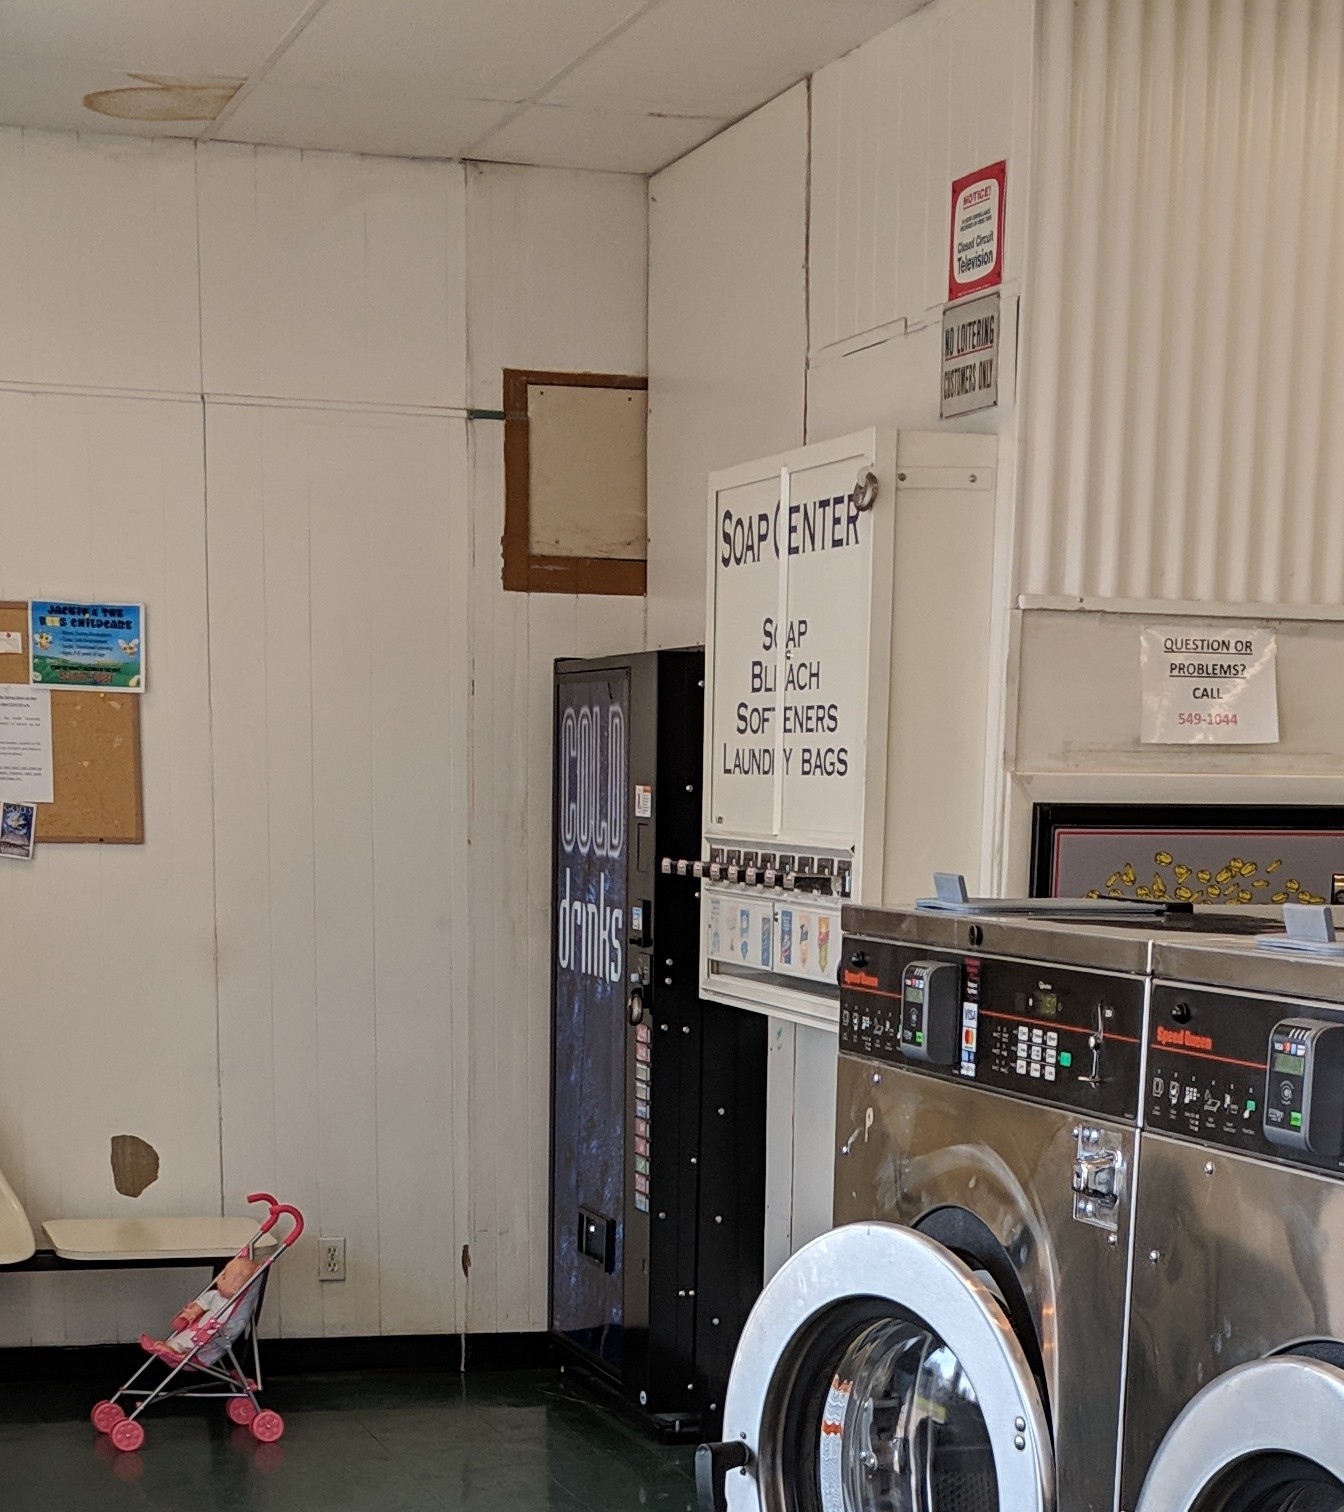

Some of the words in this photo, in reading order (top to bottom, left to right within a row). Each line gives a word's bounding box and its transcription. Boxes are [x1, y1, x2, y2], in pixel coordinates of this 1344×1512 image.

[963, 185, 992, 206] NOTICE!
[958, 236, 975, 254] Closed
[976, 230, 994, 248] Circuit
[957, 248, 994, 275] Television
[945, 327, 954, 357] NO
[957, 314, 994, 354] LOITERING
[944, 362, 976, 400] CUSTOMERS
[978, 358, 993, 391] ONLY
[101, 607, 123, 617] THE
[39, 616, 67, 627] BS
[70, 618, 133, 630] CHILDCARE
[1164, 638, 1231, 652] QUESTION
[1235, 640, 1253, 652] OR
[1169, 662, 1246, 676] PROBLEMS?
[1192, 687, 1223, 700] CALL
[1178, 712, 1238, 726] 549-1044
[723, 743, 793, 775] LAUNDY
[801, 747, 848, 777] BAGS
[560, 704, 625, 858] COLD
[559, 867, 623, 983] drinks
[1157, 1026, 1184, 1045] Speed
